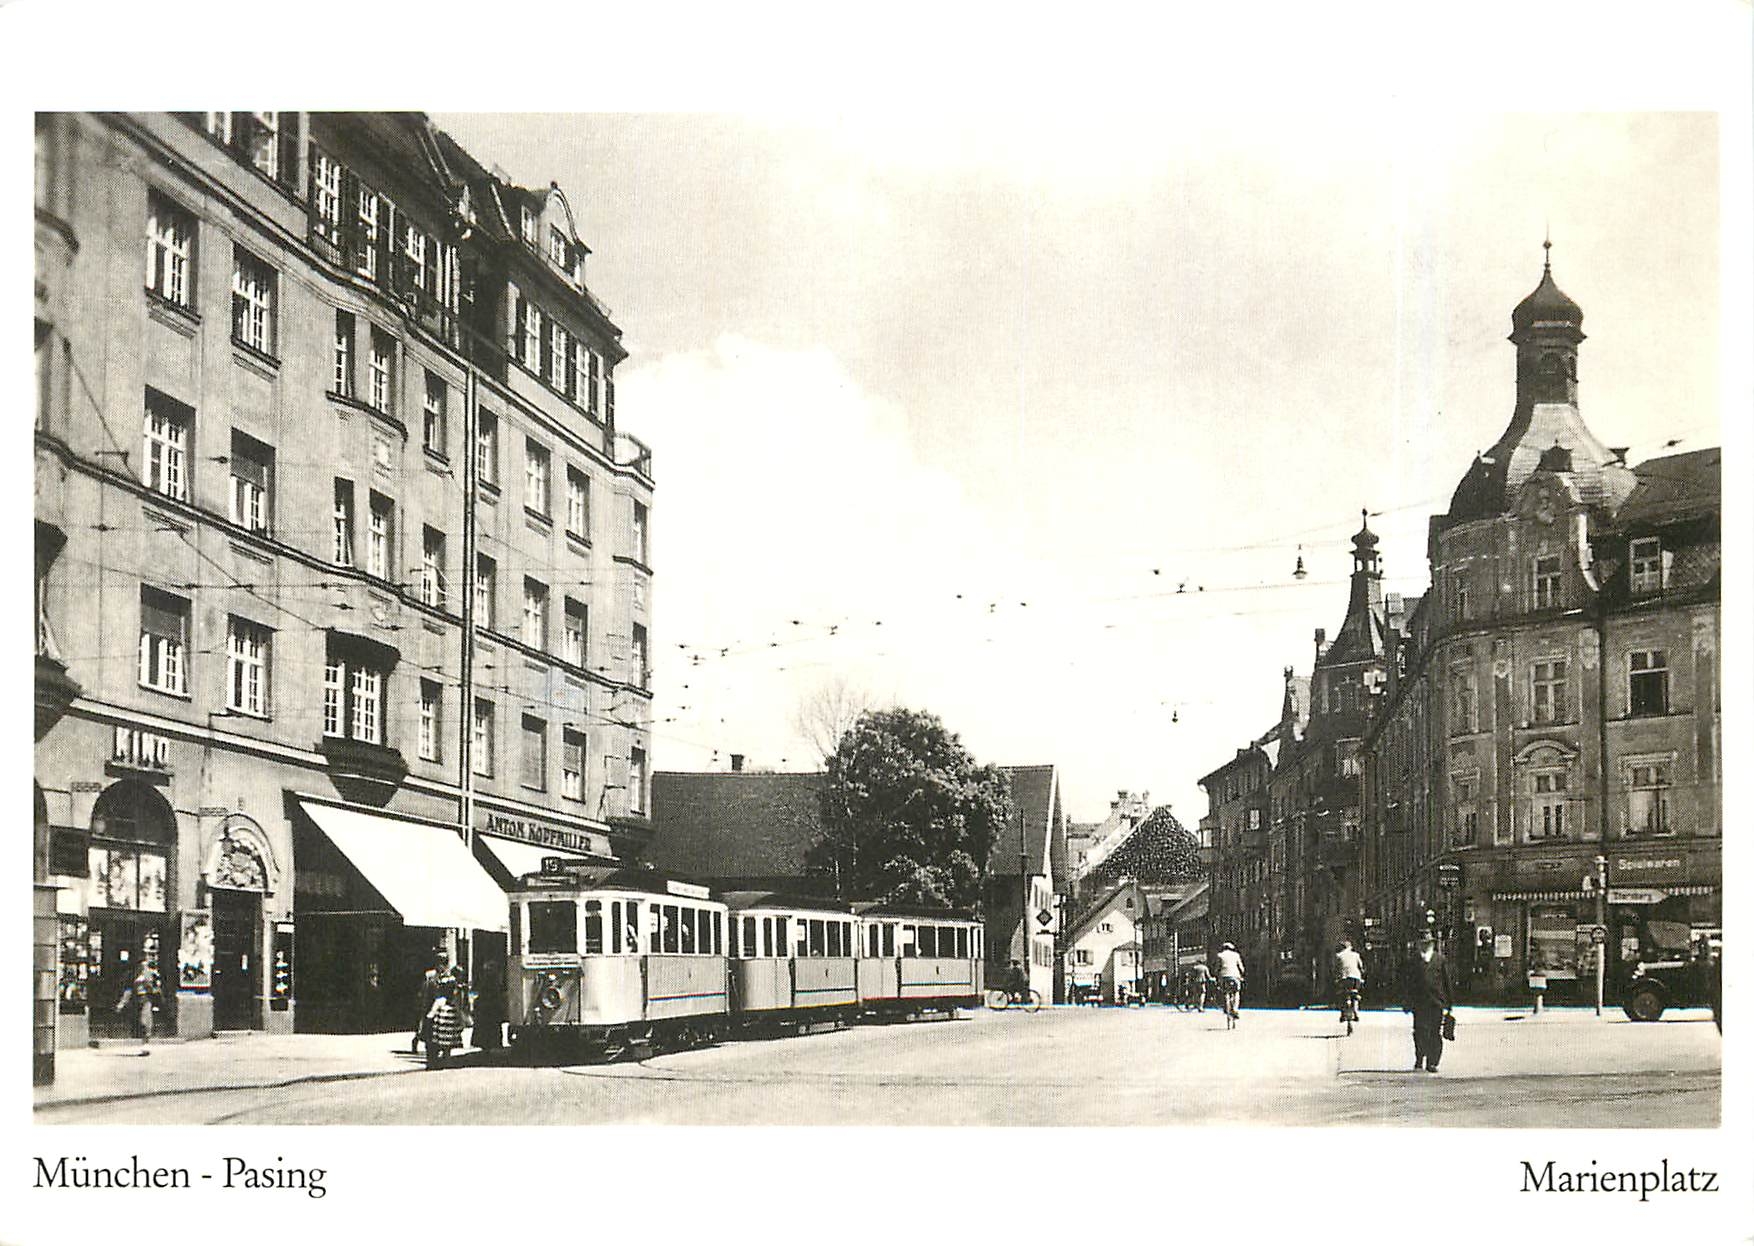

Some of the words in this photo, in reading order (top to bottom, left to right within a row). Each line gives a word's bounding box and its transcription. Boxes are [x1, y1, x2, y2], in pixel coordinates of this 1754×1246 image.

[115, 727, 169, 763] KINO
[486, 813, 524, 838] ANTON
[1618, 858, 1681, 870] Spielwaren
